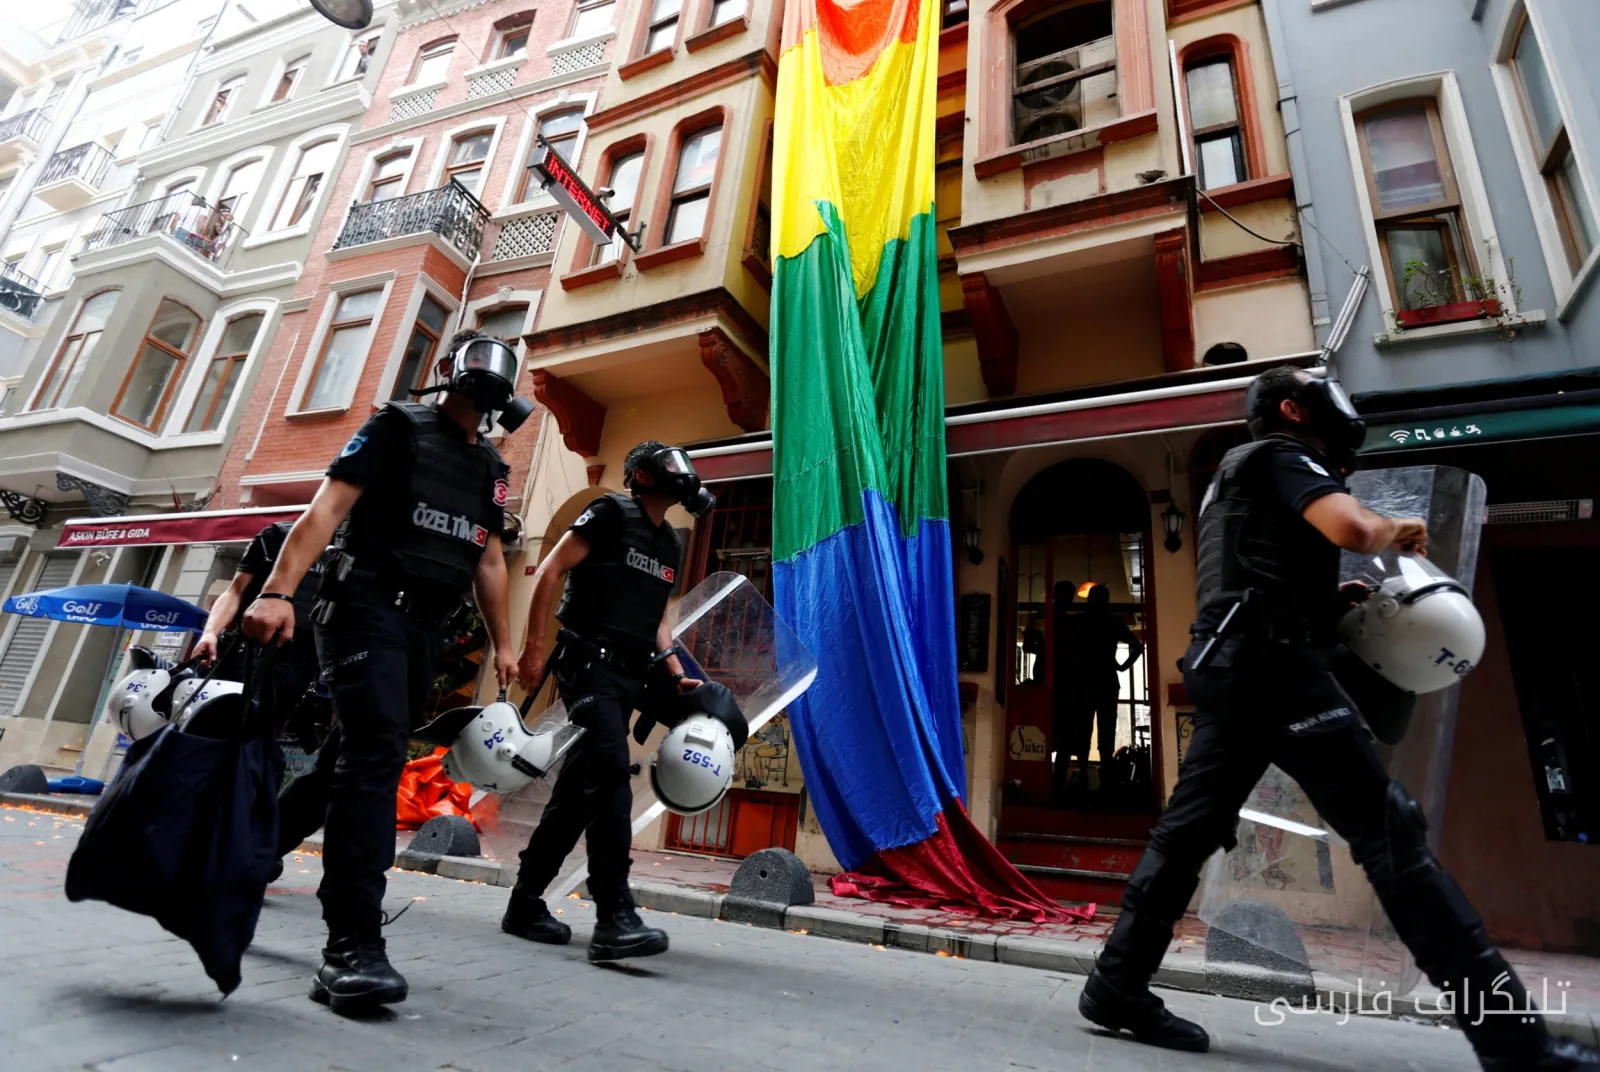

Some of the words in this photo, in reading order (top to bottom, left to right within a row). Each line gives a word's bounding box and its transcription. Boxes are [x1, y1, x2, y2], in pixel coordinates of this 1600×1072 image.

[413, 501, 450, 534] ÖZEL
[451, 515, 477, 543] TİM
[95, 528, 119, 539] BÜFE
[127, 528, 150, 539] GIDA
[626, 547, 650, 573] ÖZEL
[62, 600, 102, 615] Golf
[145, 609, 180, 624] Golf
[483, 731, 504, 750] 34
[683, 749, 721, 777] T-552
